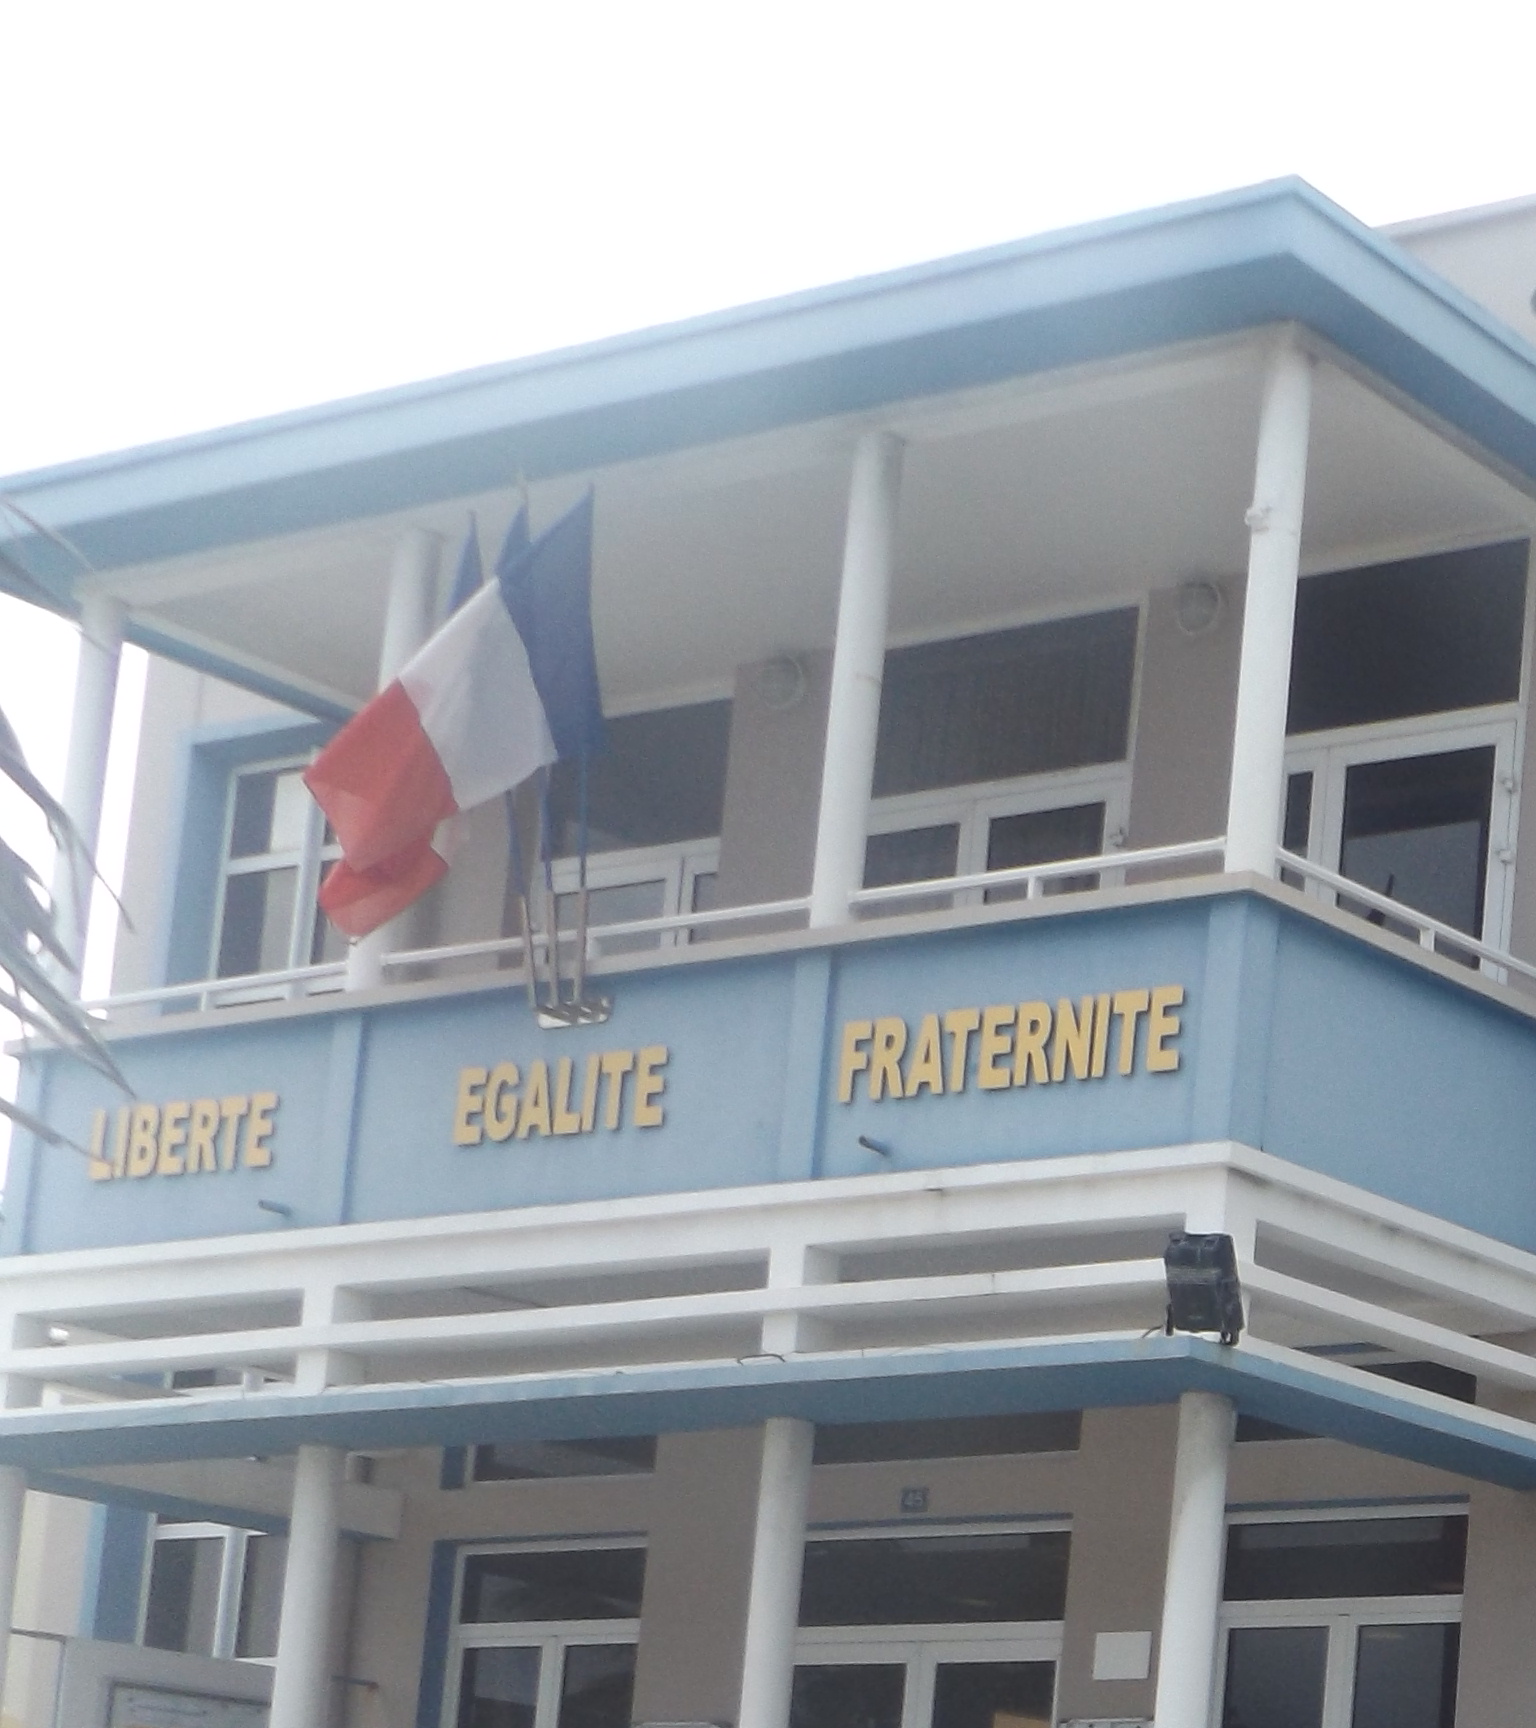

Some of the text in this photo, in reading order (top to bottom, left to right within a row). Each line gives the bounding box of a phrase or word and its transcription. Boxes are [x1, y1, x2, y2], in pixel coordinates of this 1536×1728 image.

[89, 985, 1187, 1182] LIBERTE EGALITE FRATERNITE
